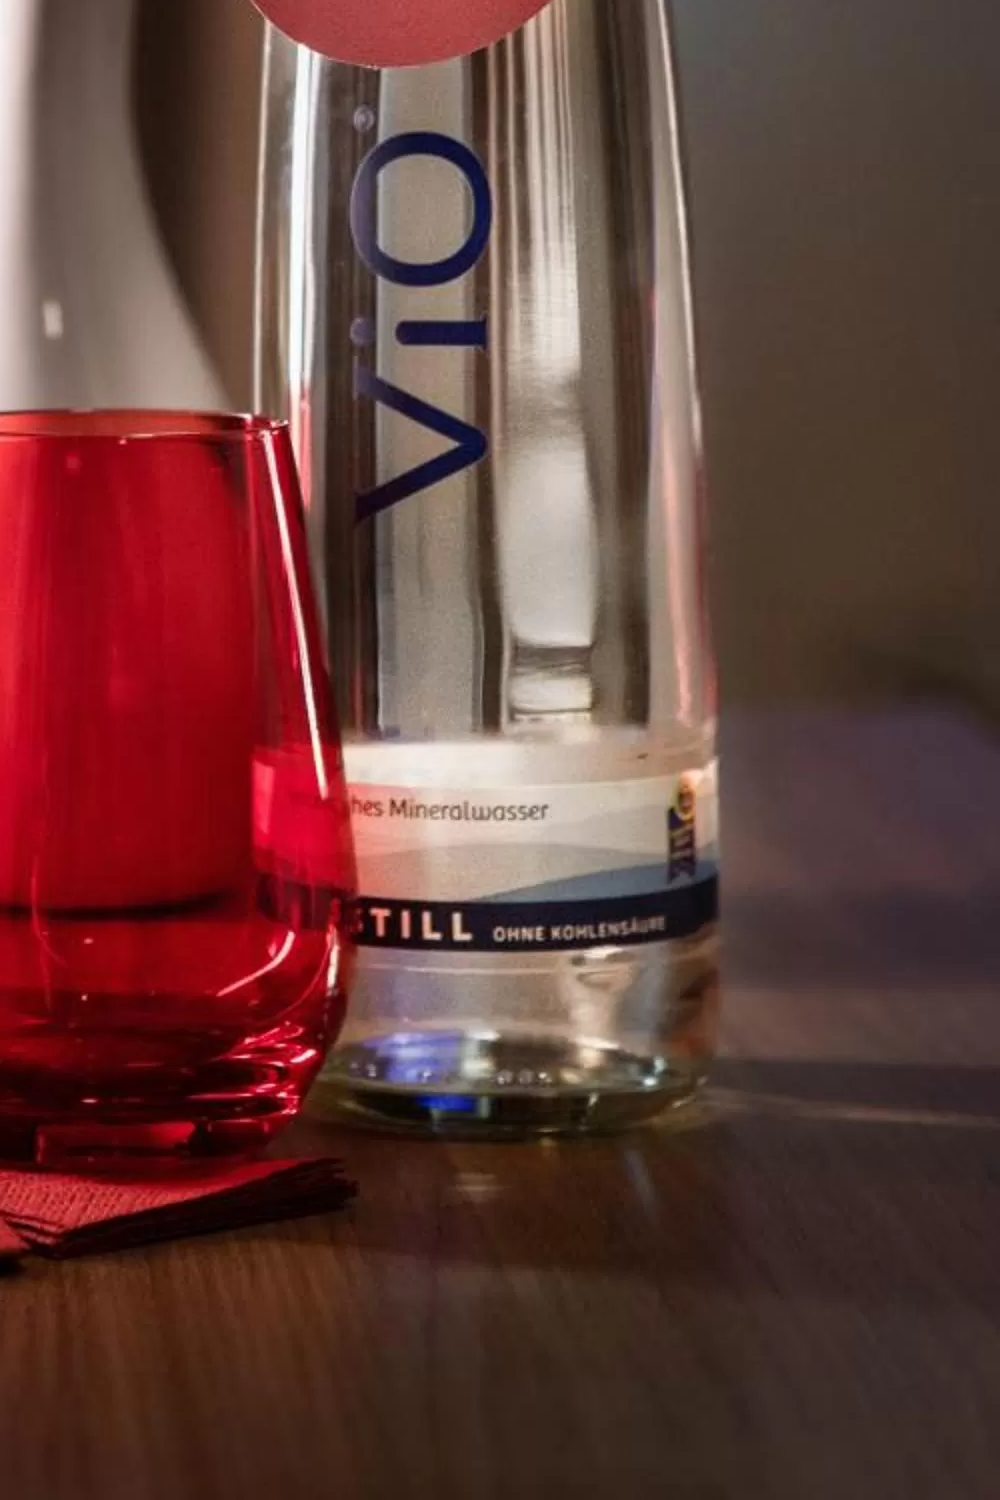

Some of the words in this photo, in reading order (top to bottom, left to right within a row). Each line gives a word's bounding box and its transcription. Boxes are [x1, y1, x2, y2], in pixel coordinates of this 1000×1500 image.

[350, 796, 385, 818] hes
[389, 797, 550, 822] Mineralwasser
[492, 925, 546, 943] OHNE
